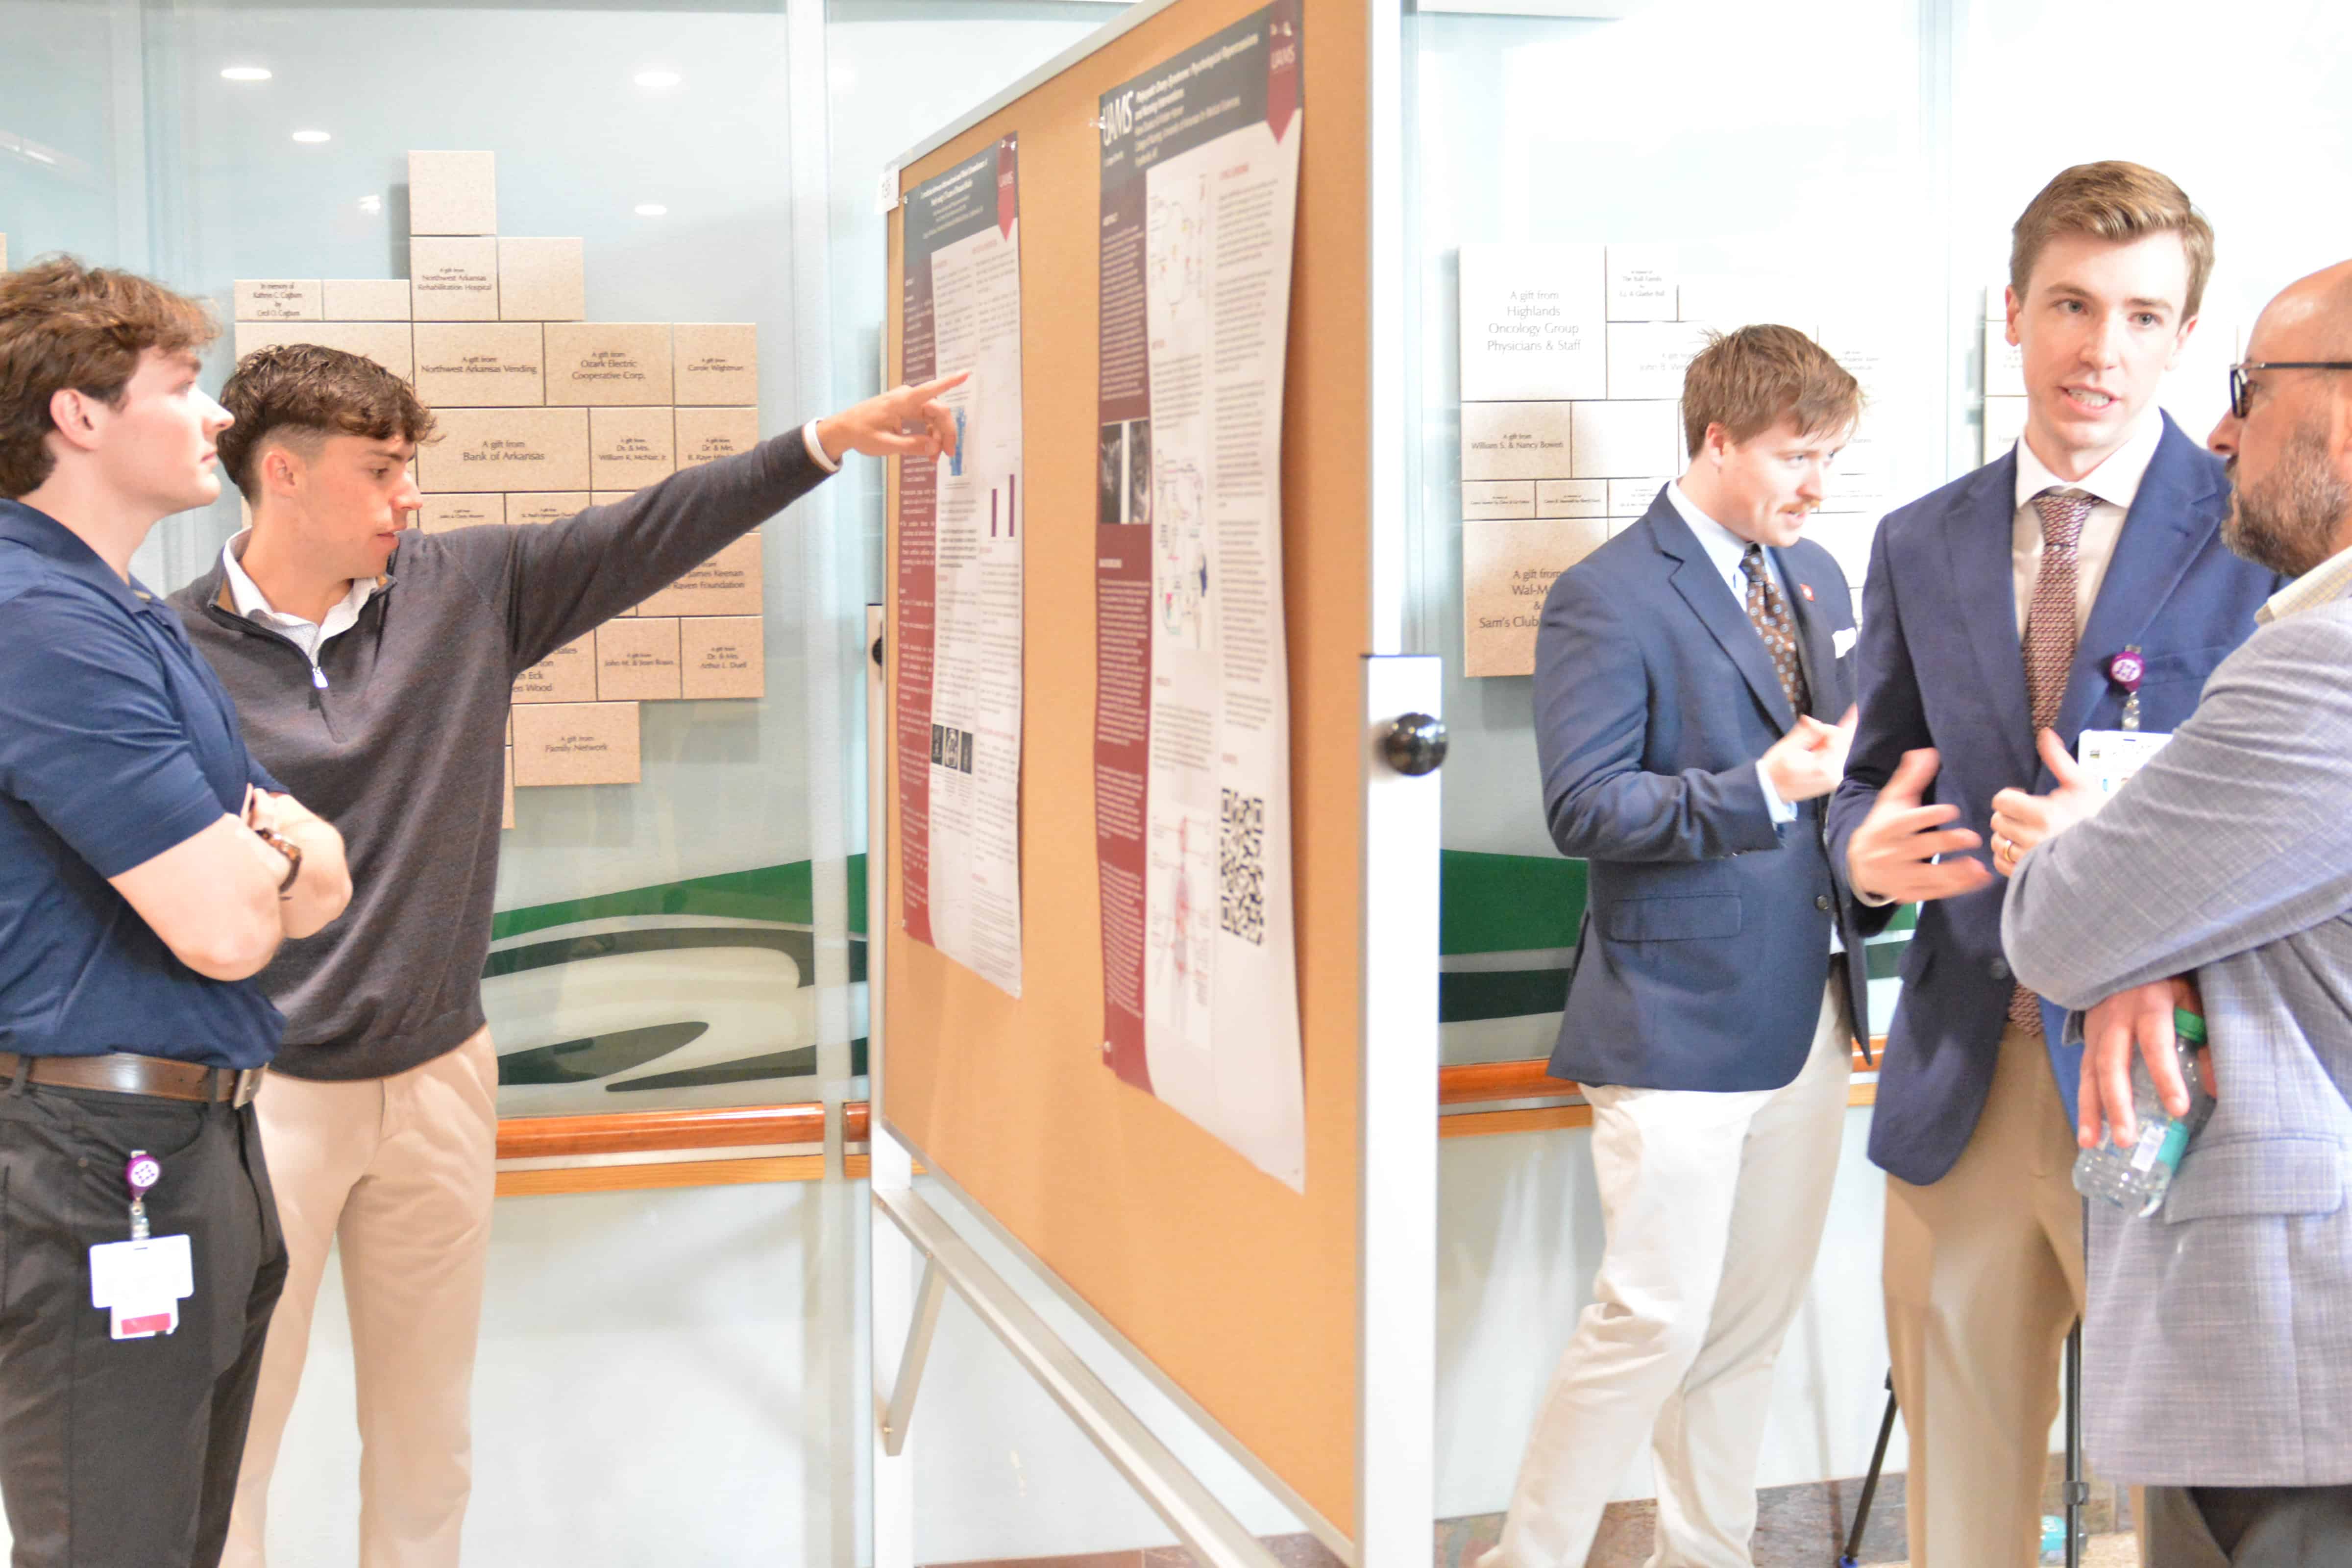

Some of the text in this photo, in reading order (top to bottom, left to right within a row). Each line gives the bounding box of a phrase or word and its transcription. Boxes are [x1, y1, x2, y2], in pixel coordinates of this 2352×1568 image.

[1103, 90, 1134, 146] UAMS
[465, 283, 491, 292] Hospital
[1510, 290, 1559, 303] A gift from
[1507, 305, 1561, 320] Highlands
[1488, 321, 1579, 338] Oncology Group
[1487, 339, 1582, 356] Physicians & Staff
[598, 351, 609, 360] gift
[581, 359, 637, 368] Ozark Electric
[421, 364, 538, 375] Northwest Arkansas Vending
[572, 371, 646, 382] Cooperative Corp.
[490, 440, 504, 450] gift
[505, 439, 526, 447] from
[1508, 441, 1514, 449] &
[1516, 441, 1538, 451] Nancy
[1540, 440, 1564, 448] Bowen
[462, 451, 545, 461] Bank of Arkansas
[1513, 570, 1521, 579] A
[1523, 568, 1537, 582] gift
[700, 581, 745, 589] Foundation
[1512, 584, 1548, 595] Wal-M
[1534, 600, 1542, 611] &
[1478, 615, 1540, 629] Sam's Club
[528, 670, 543, 680] Eck
[526, 682, 553, 692] Wood
[544, 743, 608, 754] Family Network
